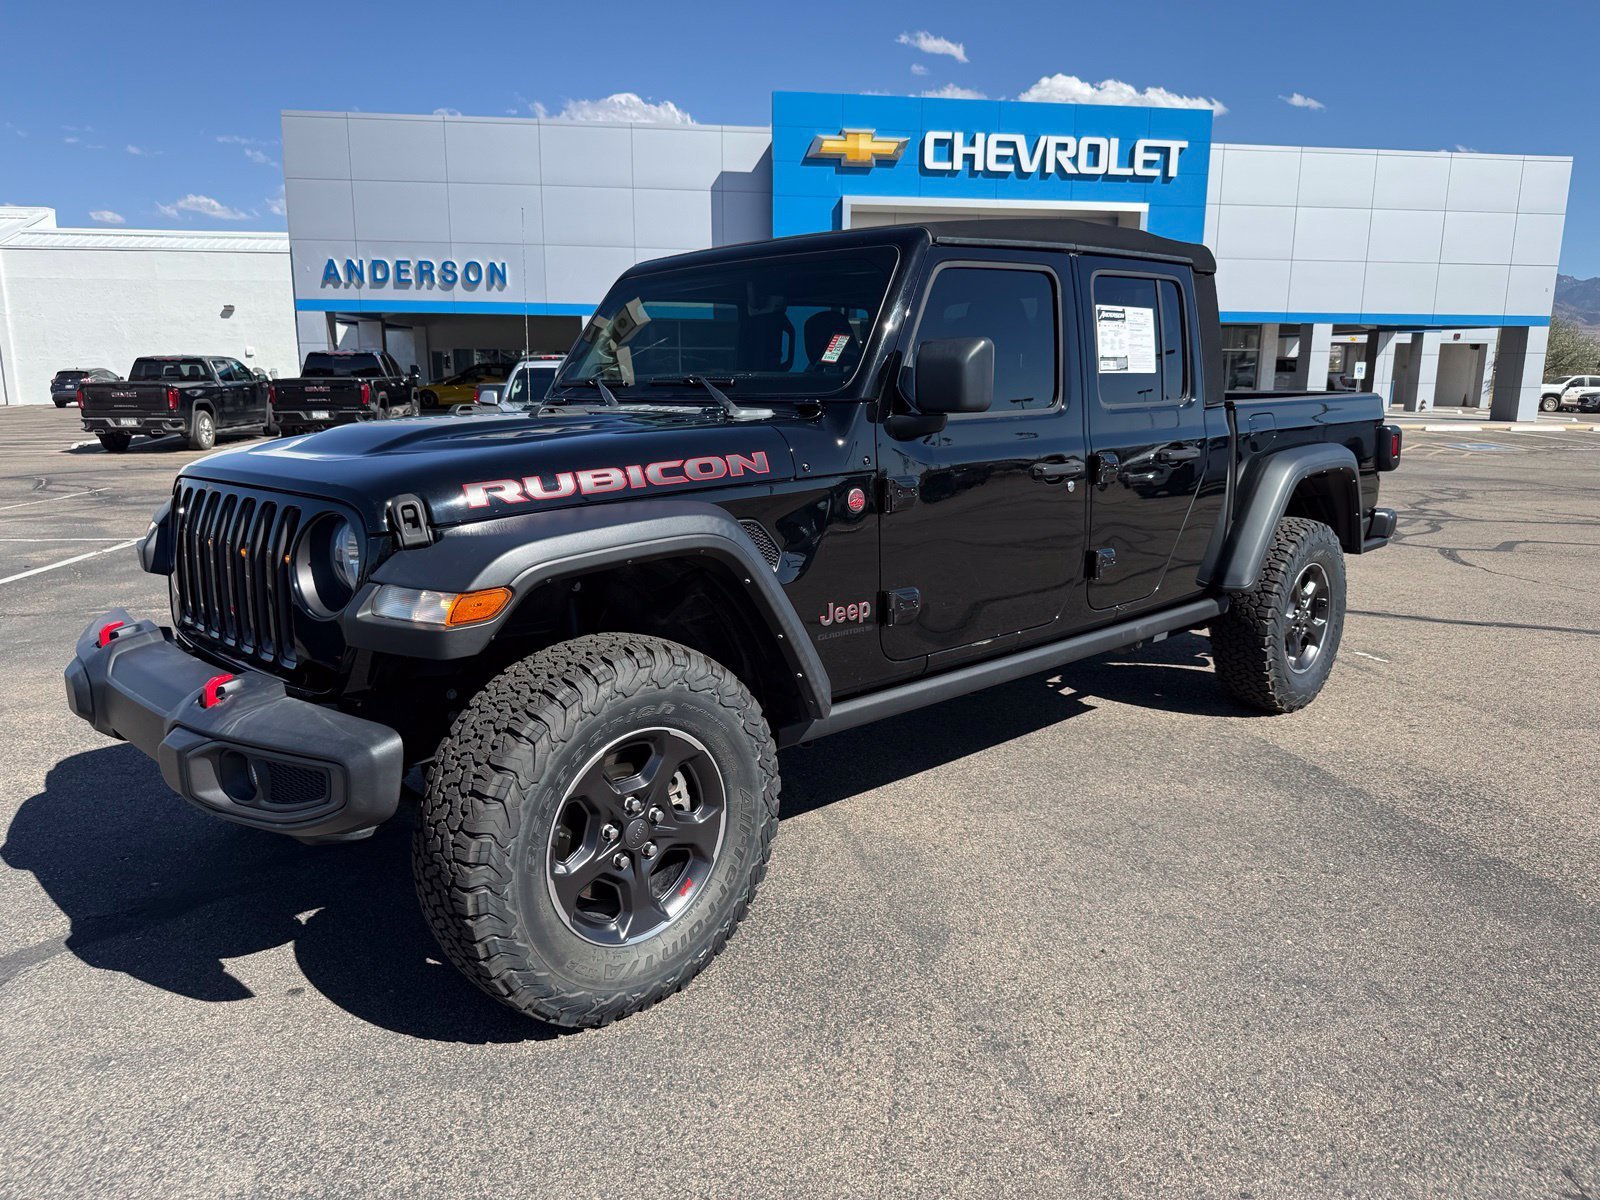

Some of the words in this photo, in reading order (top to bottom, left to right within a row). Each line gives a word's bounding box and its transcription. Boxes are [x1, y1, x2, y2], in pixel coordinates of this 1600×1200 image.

[924, 131, 1189, 177] CHEVROLET
[322, 259, 508, 286] ANDERSON
[462, 451, 770, 508] RUBICON
[820, 601, 871, 627] Jeep
[817, 626, 864, 641] GLADIATOR
[525, 701, 676, 877] BFGoodrich
